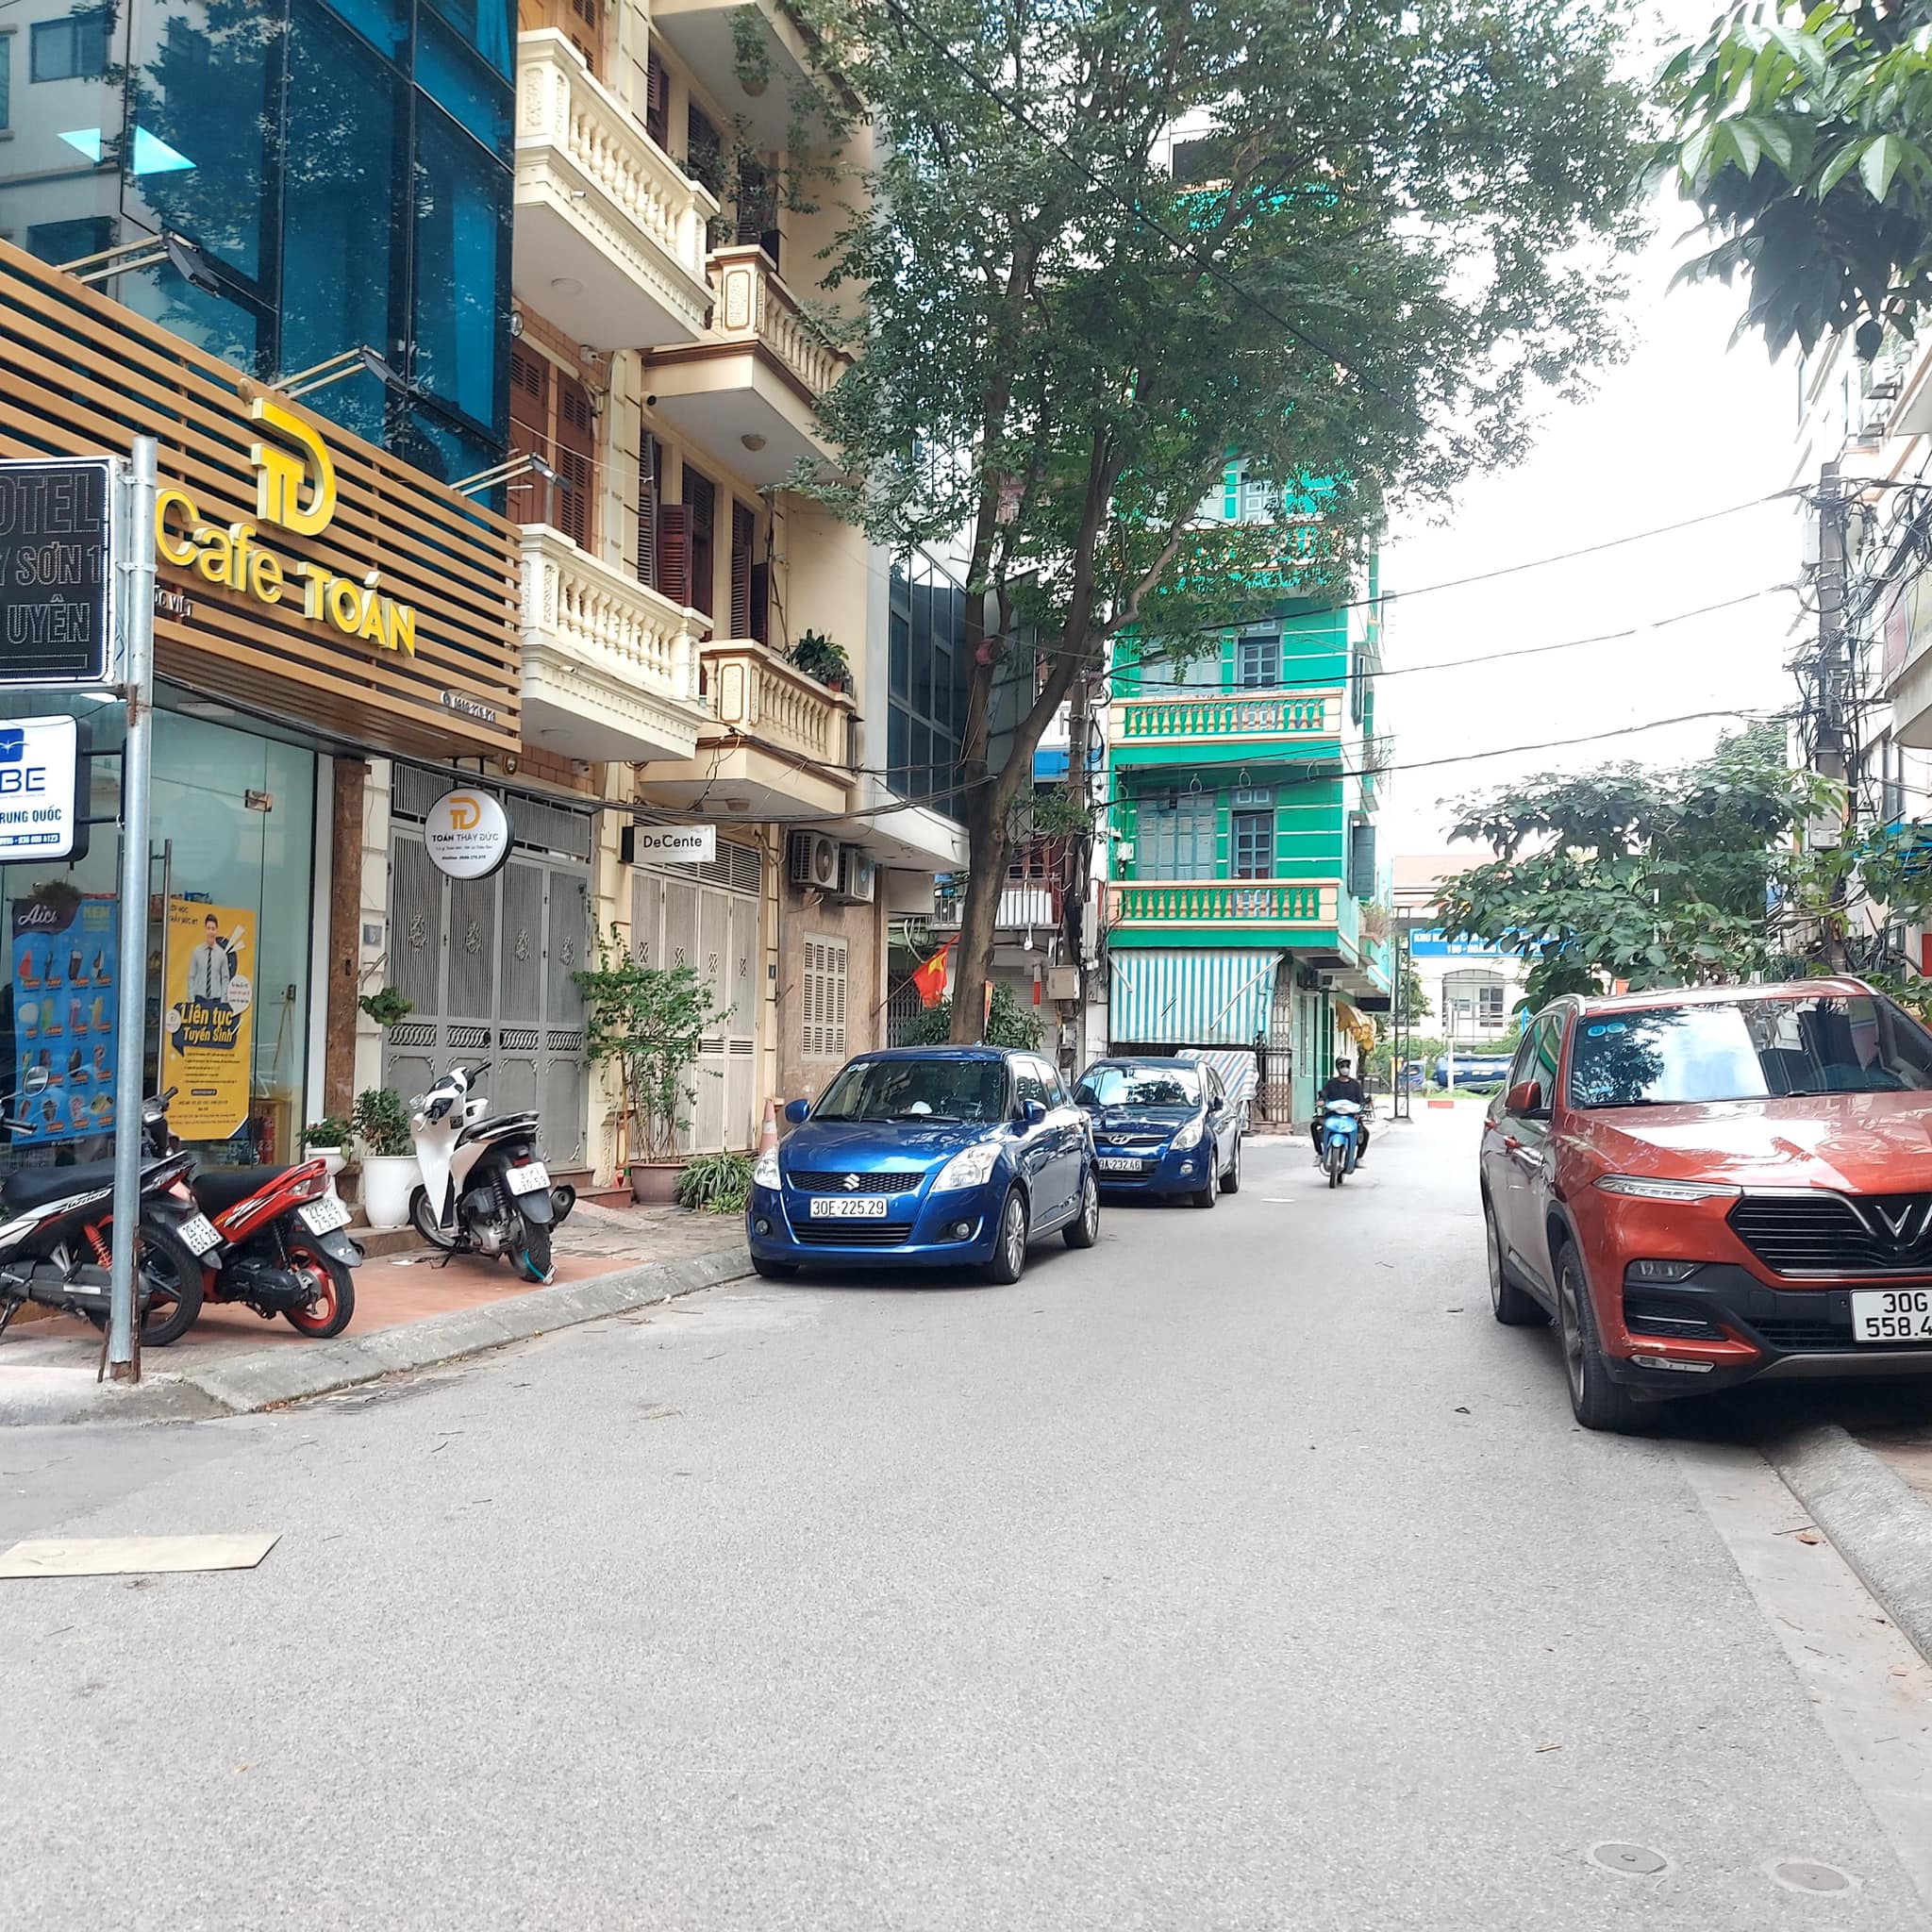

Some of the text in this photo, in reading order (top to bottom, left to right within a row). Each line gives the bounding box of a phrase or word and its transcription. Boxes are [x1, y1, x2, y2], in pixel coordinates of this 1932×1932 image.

[15, 541, 82, 586] SƠN
[86, 544, 101, 584] 1
[156, 488, 416, 658] Cafe TOÁN
[7, 593, 91, 644] UYÊN
[32, 805, 62, 823] QUỐC
[180, 1002, 233, 1028] Liên tục
[212, 1027, 234, 1043] Sinh
[1882, 1292, 1928, 1313] 30G
[1865, 1316, 1932, 1338] 558.4
